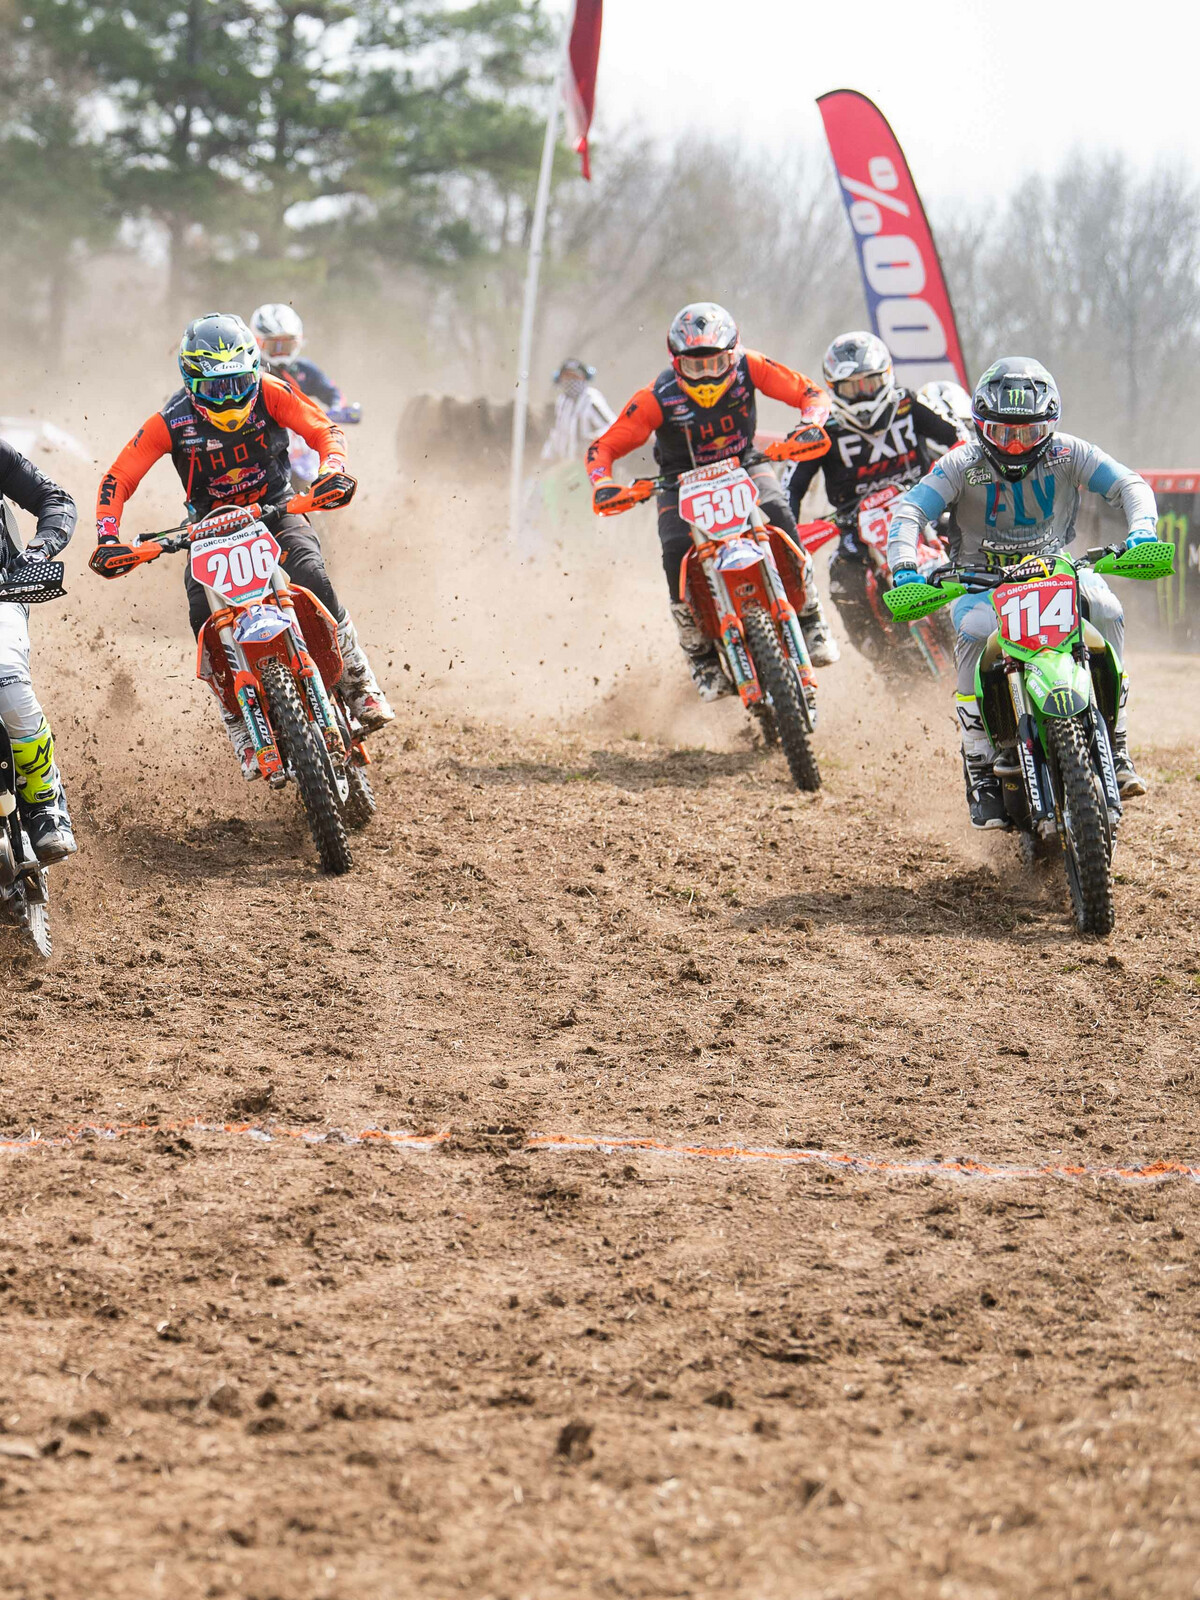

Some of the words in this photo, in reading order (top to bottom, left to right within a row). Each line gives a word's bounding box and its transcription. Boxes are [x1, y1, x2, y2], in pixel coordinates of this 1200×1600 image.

[837, 414, 918, 468] FXR
[691, 482, 754, 532] 530
[984, 473, 1055, 529] FLY
[203, 529, 264, 548] GNCCRACING.CM
[207, 538, 275, 594] 206
[1006, 580, 1073, 596] GNCCRACING.COM
[1000, 588, 1075, 642] 114
[729, 627, 753, 680] DNLOP
[244, 686, 273, 746] DNLOP
[305, 684, 325, 728] DUNLO
[1021, 741, 1043, 812] DUNLOP
[1094, 728, 1117, 802] DUNLOP
